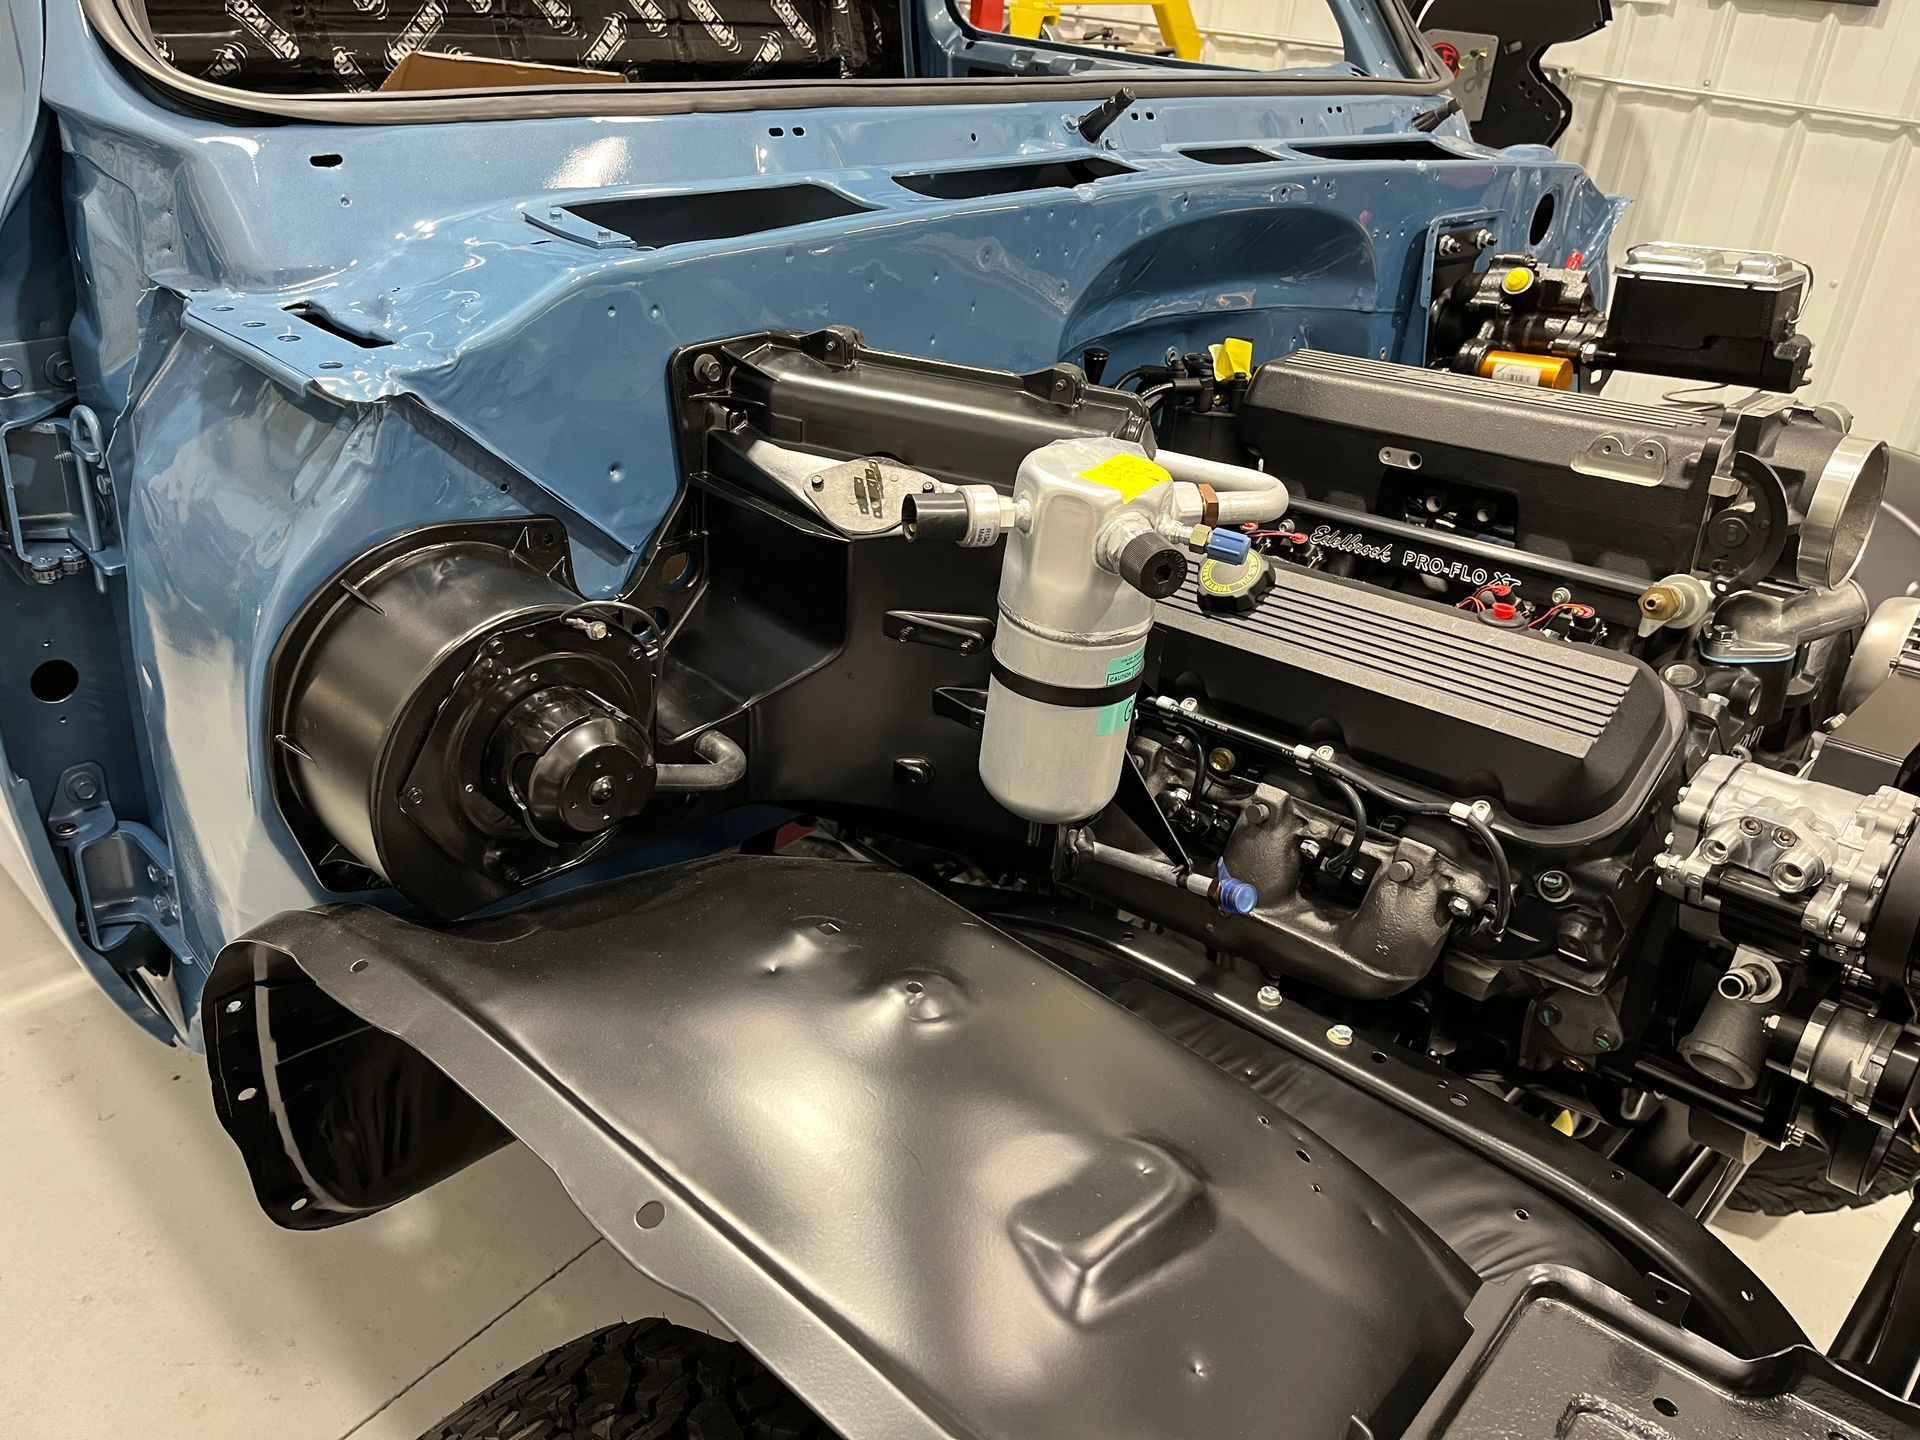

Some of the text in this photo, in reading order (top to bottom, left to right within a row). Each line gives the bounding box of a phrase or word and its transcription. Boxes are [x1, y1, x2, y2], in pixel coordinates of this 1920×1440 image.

[389, 25, 425, 63] BOOM
[1310, 525, 1393, 563] Edelbrock
[1402, 550, 1487, 585] PRO-FLO
[1109, 671, 1132, 683] CAUTION
